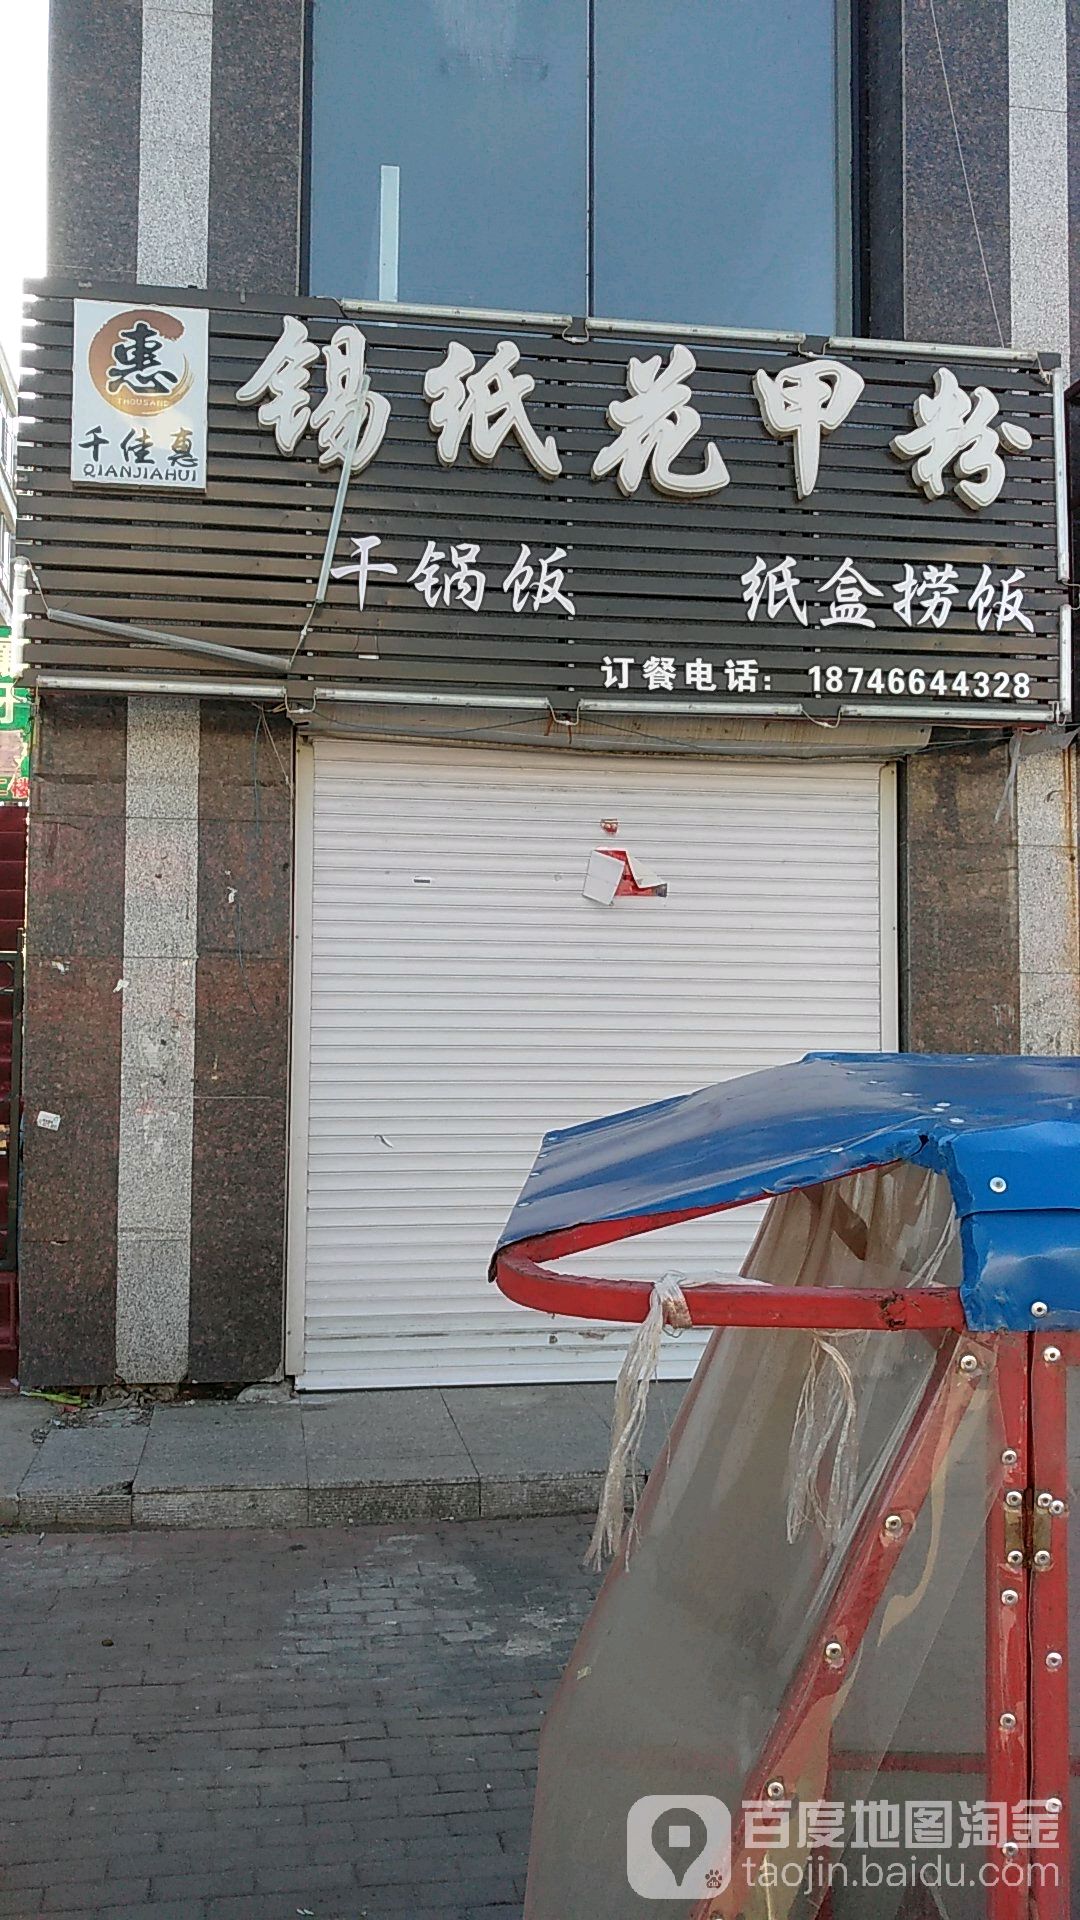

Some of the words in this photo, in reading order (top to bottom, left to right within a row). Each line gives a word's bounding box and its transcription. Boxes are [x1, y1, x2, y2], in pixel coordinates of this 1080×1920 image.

[236, 315, 1033, 510] 锡纸花甲粉
[78, 425, 198, 467] 千佳惠
[83, 463, 197, 482] QIANJIAHUI
[330, 535, 576, 615] 干锅饭
[741, 555, 1035, 633] 纸盒捞饭
[808, 665, 1031, 698] 18746644328
